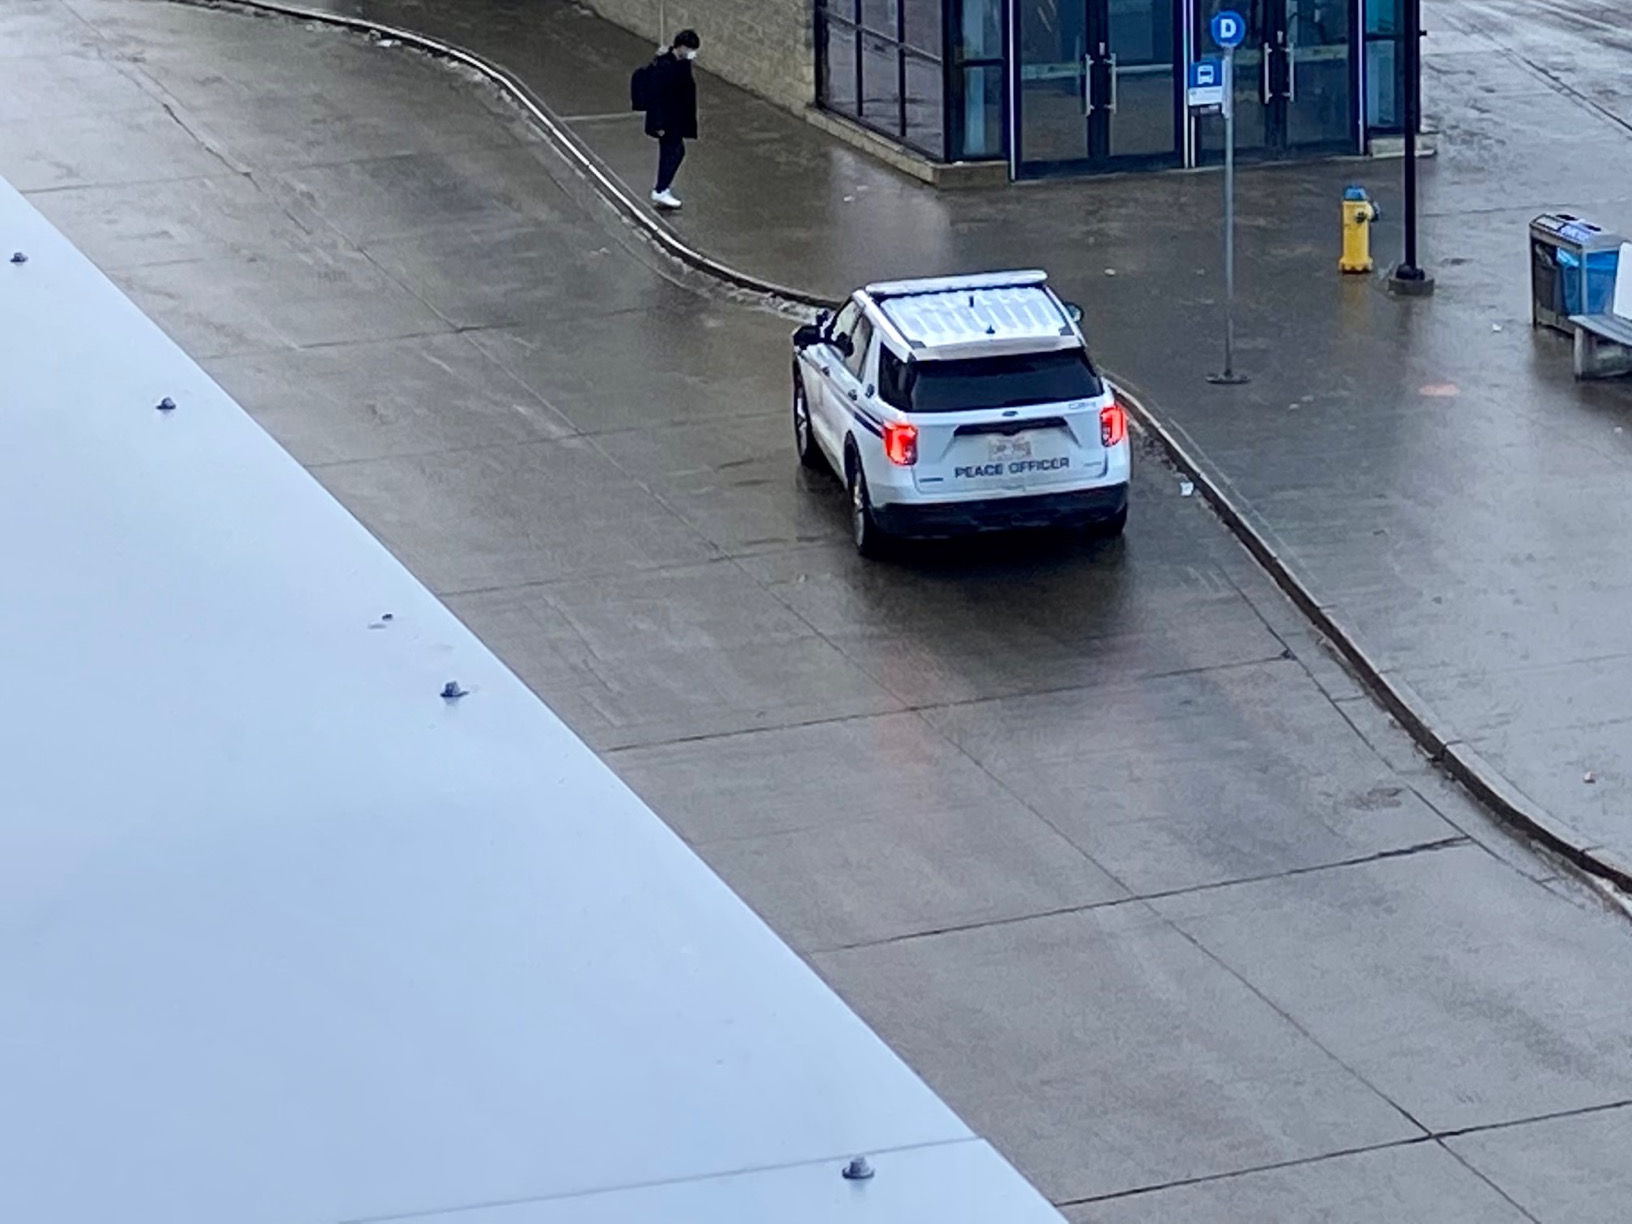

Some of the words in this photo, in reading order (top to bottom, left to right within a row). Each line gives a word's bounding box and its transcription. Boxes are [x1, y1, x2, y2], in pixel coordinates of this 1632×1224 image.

[1220, 18, 1237, 38] D
[954, 464, 1003, 479] PEACE
[1008, 457, 1070, 475] OFFICER
